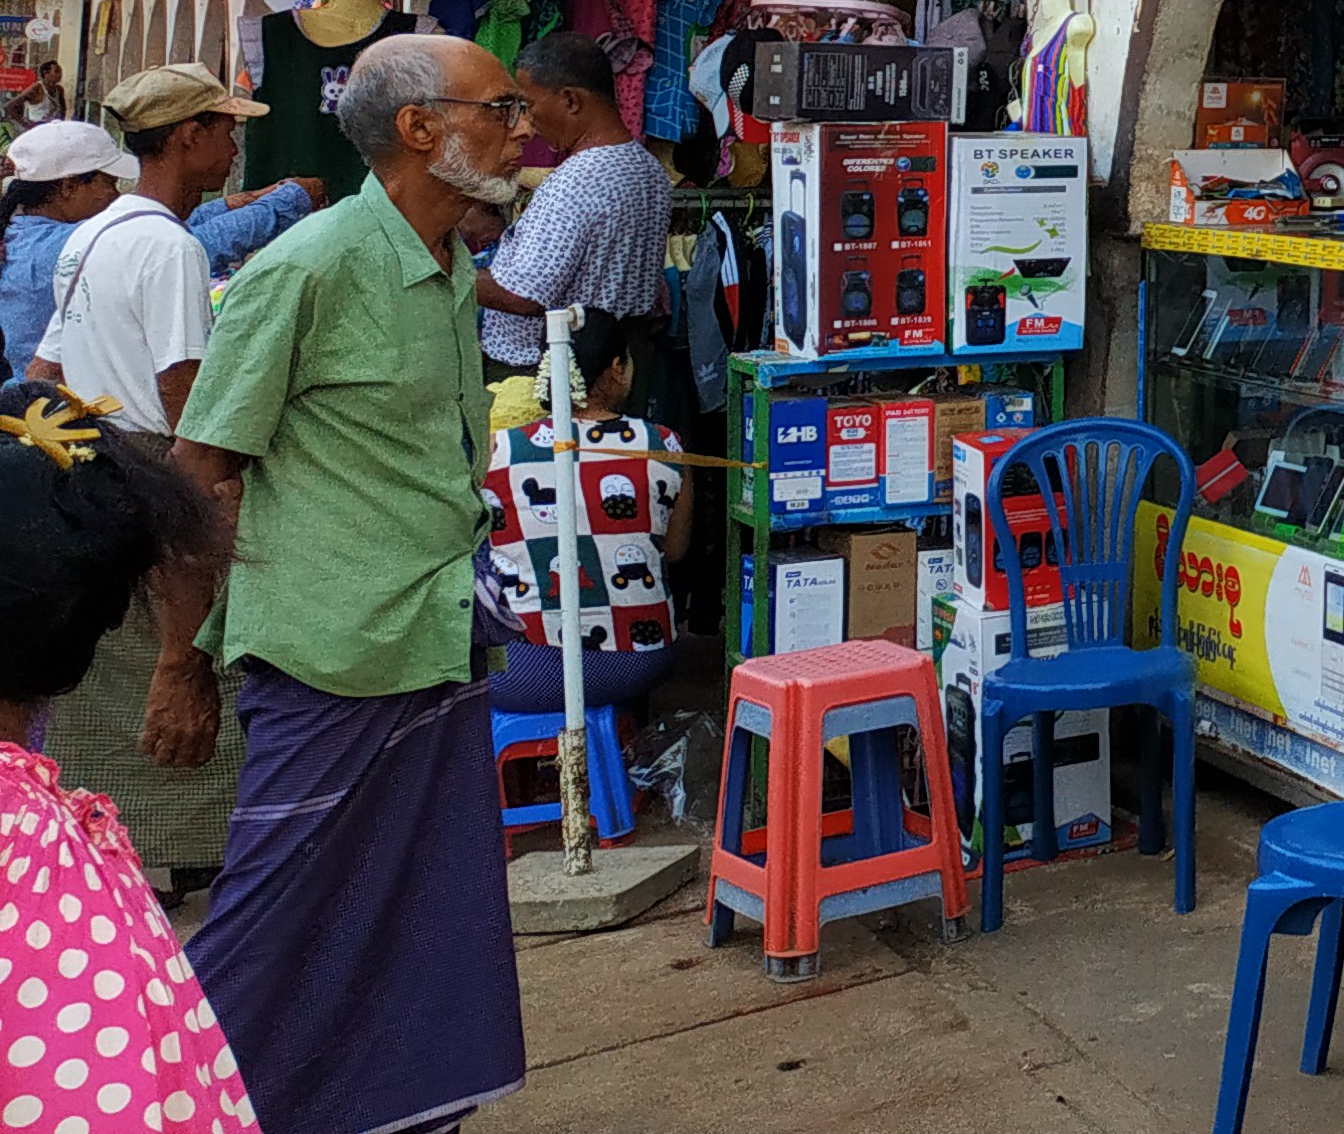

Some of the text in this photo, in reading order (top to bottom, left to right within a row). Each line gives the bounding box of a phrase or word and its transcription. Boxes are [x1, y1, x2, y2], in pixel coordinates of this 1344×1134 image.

[973, 148, 1075, 160] BT SPEAKER
[1243, 206, 1267, 220] 4G
[1025, 317, 1045, 329] FM
[834, 414, 872, 428] TOYO
[786, 577, 818, 588] TATA
